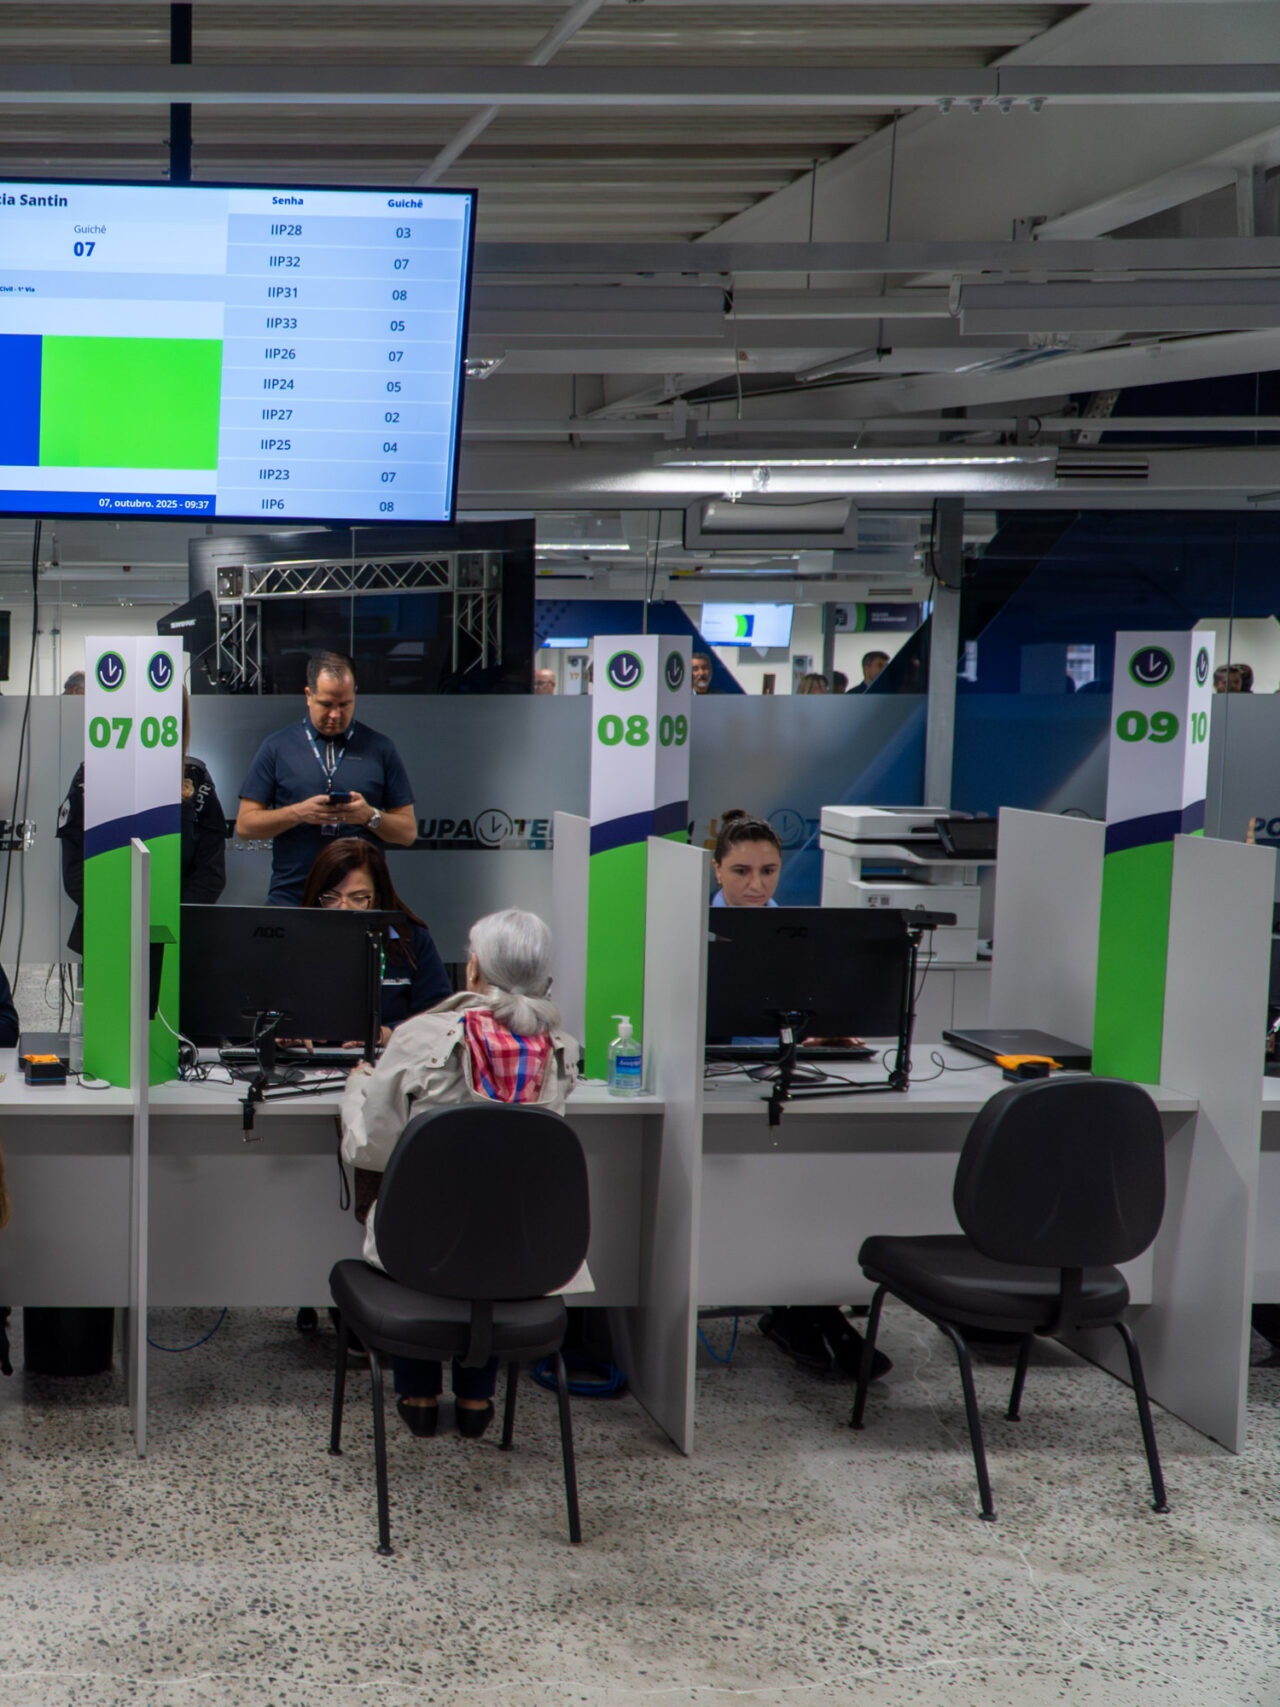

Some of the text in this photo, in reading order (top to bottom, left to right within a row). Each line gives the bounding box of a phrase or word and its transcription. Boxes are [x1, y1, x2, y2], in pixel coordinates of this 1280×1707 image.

[20, 194, 67, 207] Santin
[272, 197, 303, 205] Senha
[388, 199, 423, 208] Guichê
[74, 225, 106, 234] Guichê
[271, 225, 411, 238] IIP28 03
[74, 242, 95, 256] 07
[270, 256, 409, 270] IIP32 07
[268, 287, 407, 301] IIP31 08
[267, 318, 405, 331] IIP33 05
[265, 348, 403, 362] IIP26 07
[264, 379, 401, 392] IIP24 05
[262, 409, 399, 423] IIP27 02
[261, 439, 397, 452] IIP25 04
[260, 469, 396, 482] IIP23 07
[99, 498, 115, 508] 07,
[114, 499, 154, 508] outubro.
[156, 500, 177, 508] 2025
[185, 501, 209, 509] 09:37
[262, 499, 394, 512] IIP6 08
[89, 716, 133, 749] 07
[140, 715, 179, 748] 08
[597, 714, 650, 747] 08
[659, 714, 688, 747] 09
[1116, 710, 1180, 743] 09
[1191, 711, 1207, 745] 10
[514, 819, 554, 839] TE
